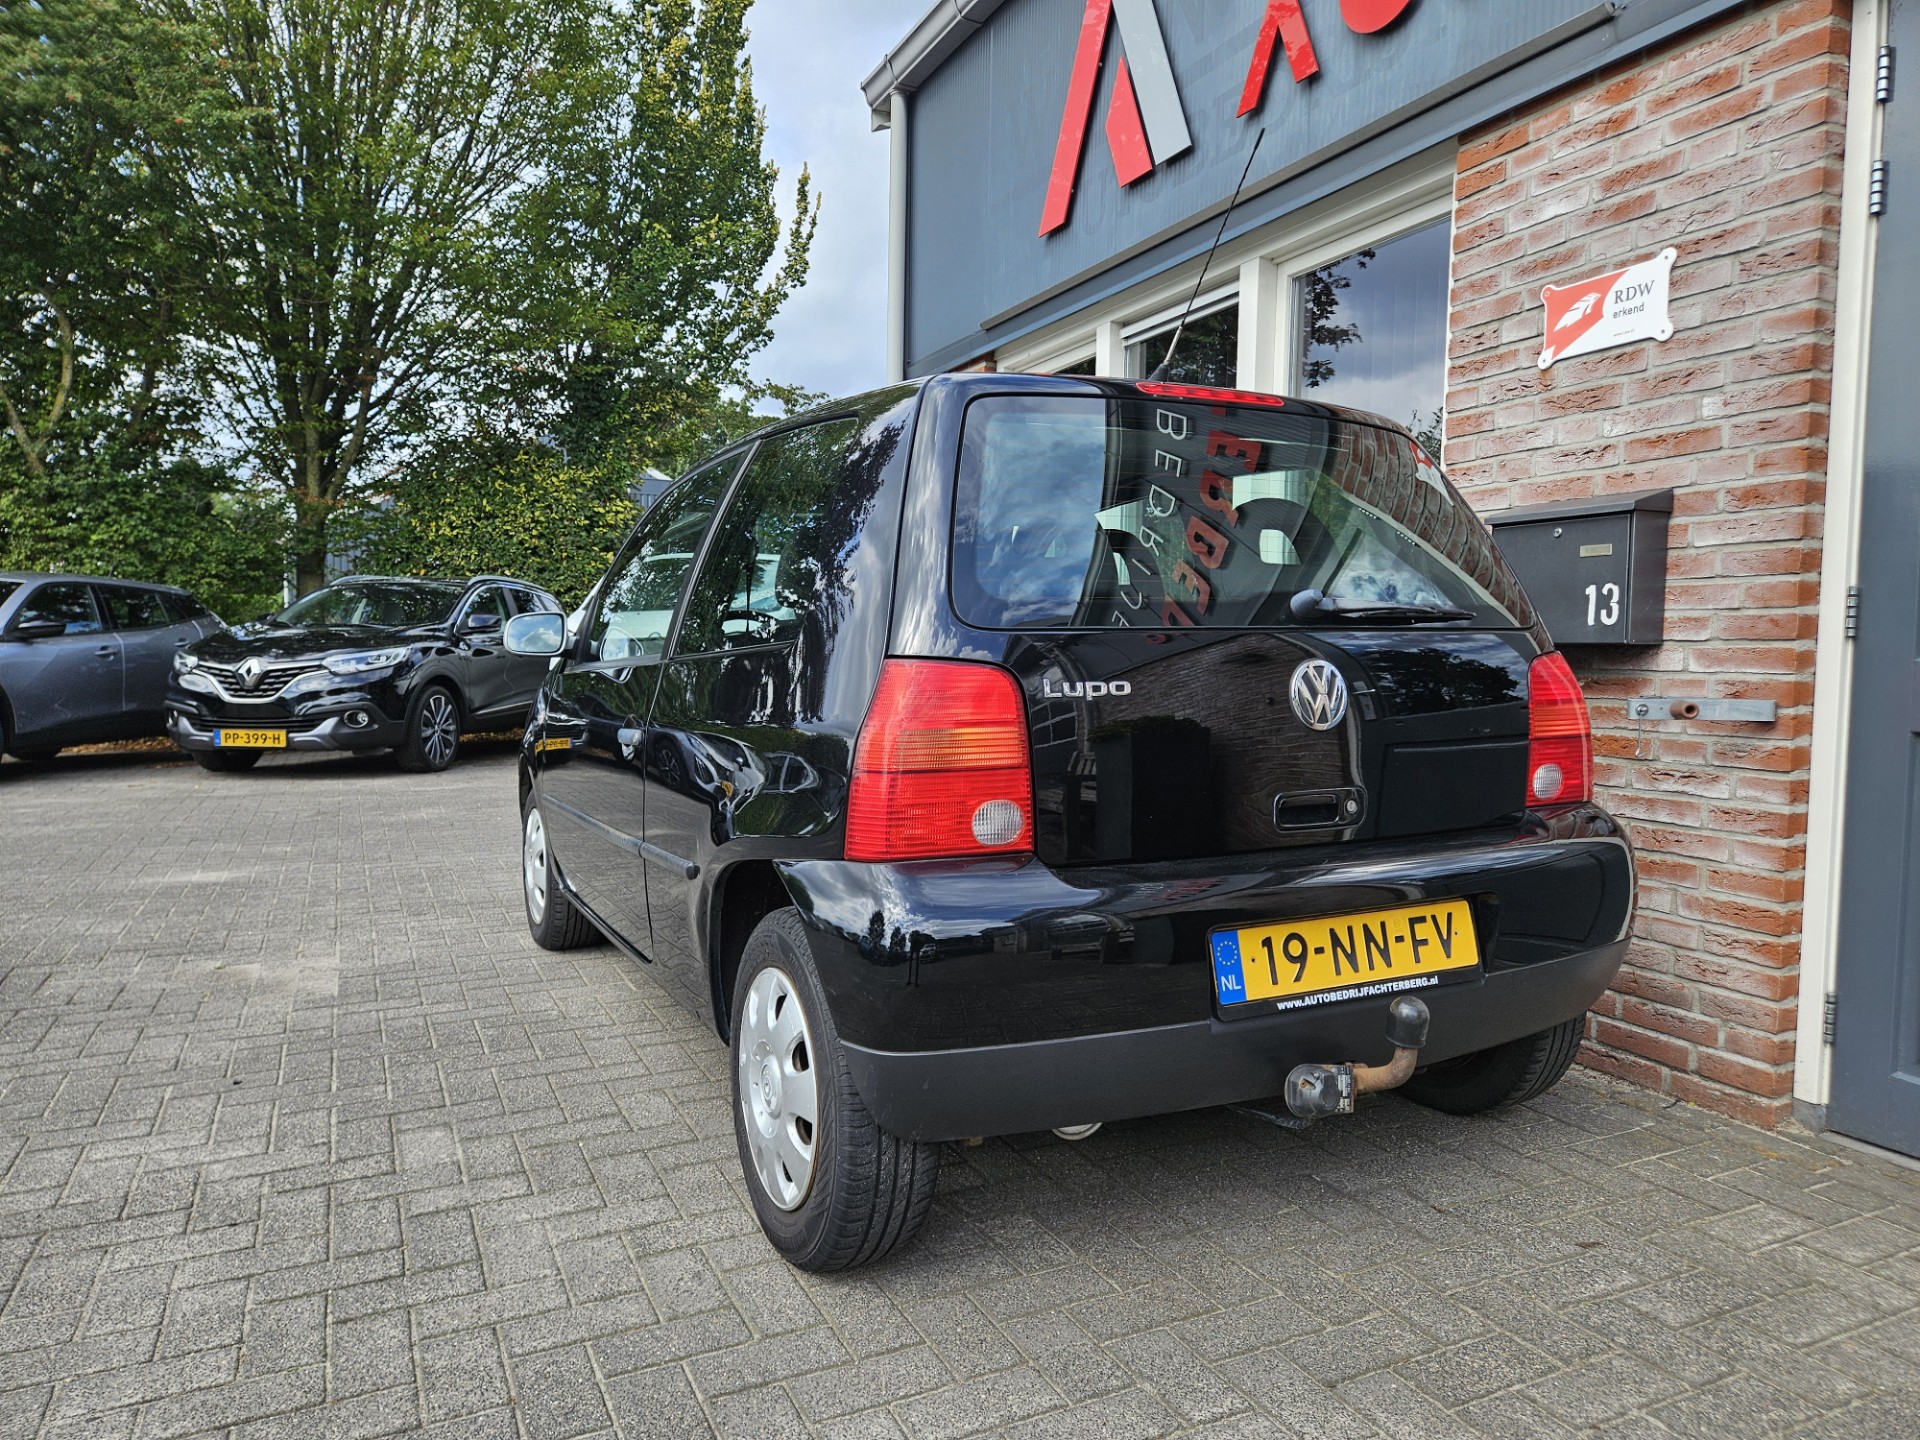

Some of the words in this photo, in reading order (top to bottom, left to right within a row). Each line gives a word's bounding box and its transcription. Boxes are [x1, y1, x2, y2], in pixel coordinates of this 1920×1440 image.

[1614, 280, 1655, 304] RDW
[1613, 302, 1645, 319] erkend
[1585, 582, 1620, 626] 13
[1043, 678, 1132, 701] Lupo
[224, 732, 281, 745] PP-399-H
[1261, 911, 1453, 985] 19-NN-FV
[1220, 974, 1241, 992] NL
[1277, 975, 1439, 1011] www.AUTOBEDRIJFACHTERBERG.nl
